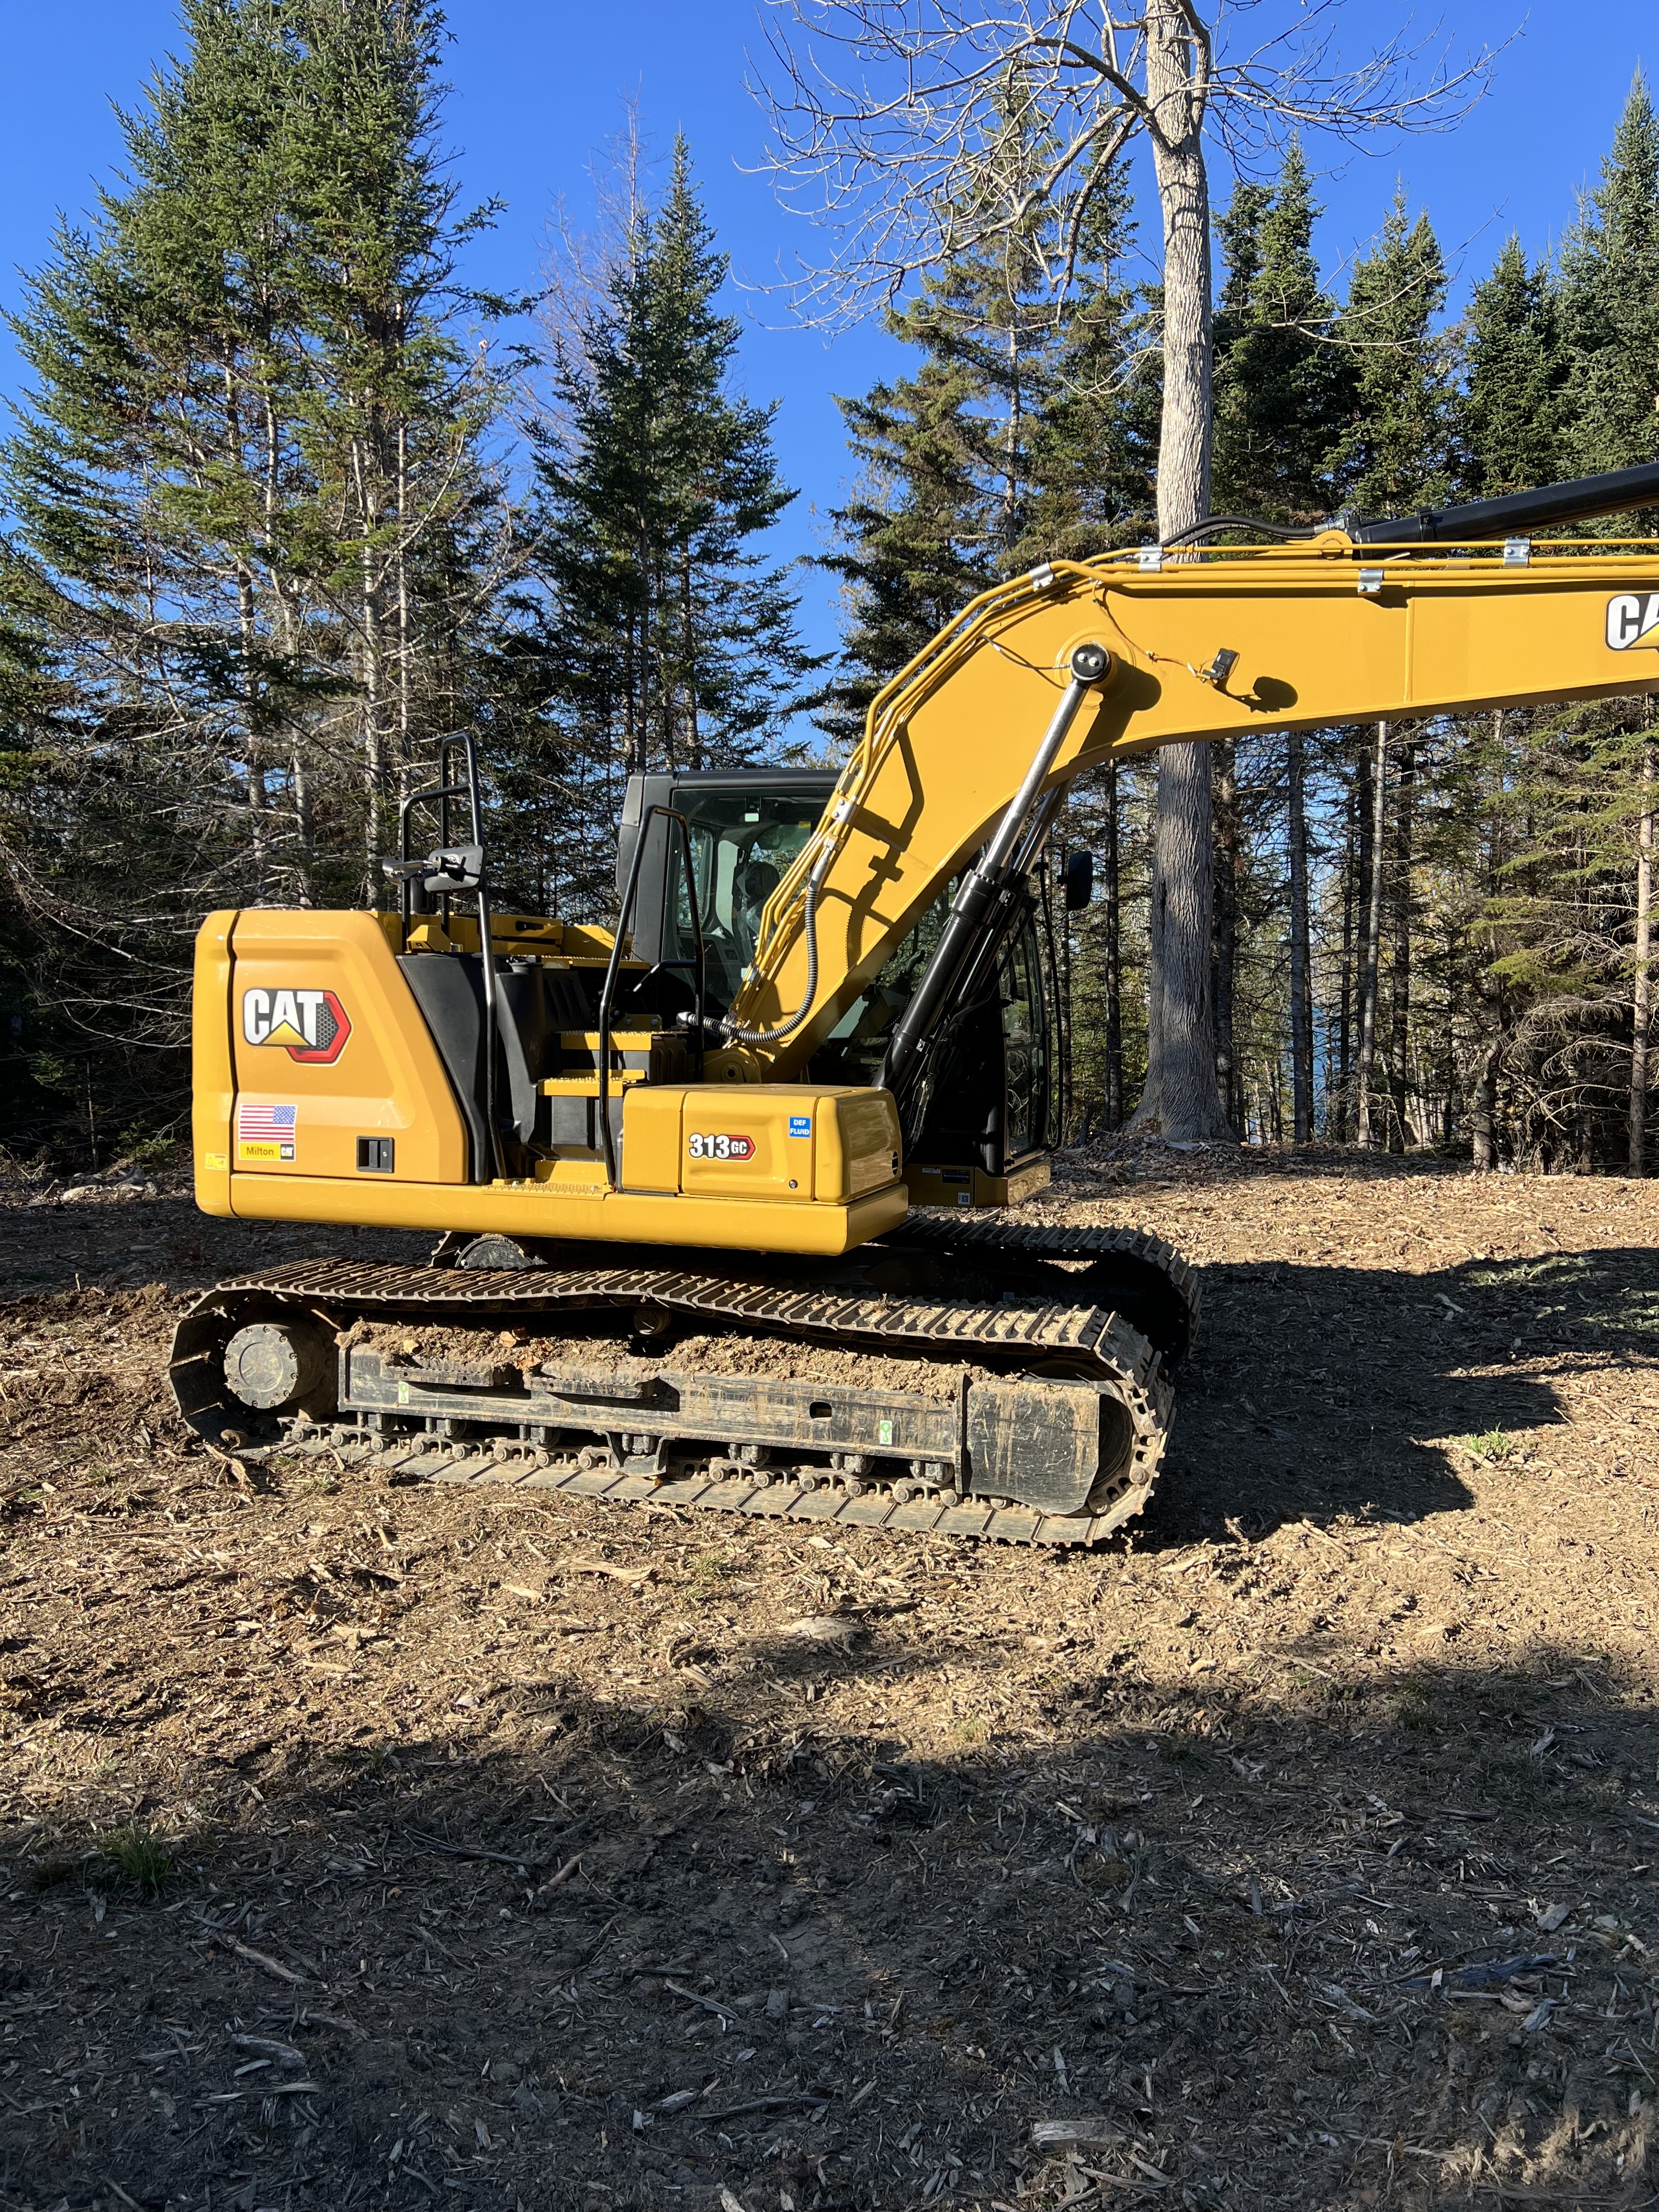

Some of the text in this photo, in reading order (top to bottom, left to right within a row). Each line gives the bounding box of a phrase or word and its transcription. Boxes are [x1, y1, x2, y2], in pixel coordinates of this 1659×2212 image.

[244, 989, 324, 1046] CAT
[246, 1147, 294, 1156] Milton CAT
[690, 1133, 747, 1158] 313 GC
